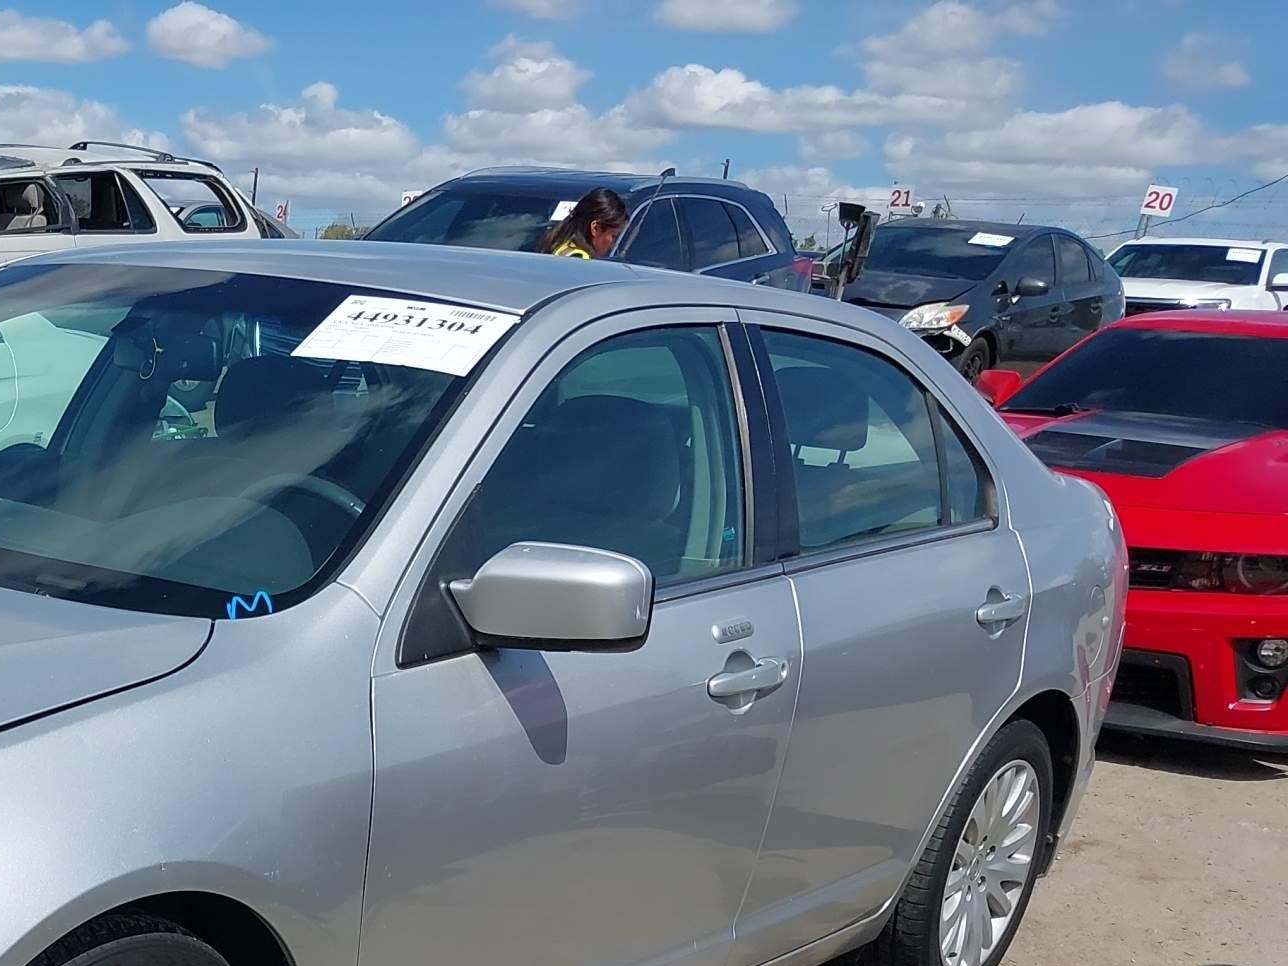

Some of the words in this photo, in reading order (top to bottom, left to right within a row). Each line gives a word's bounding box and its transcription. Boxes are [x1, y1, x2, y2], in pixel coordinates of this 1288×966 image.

[890, 190, 910, 207] 21
[1144, 191, 1173, 211] 20
[346, 309, 484, 335] 44931304
